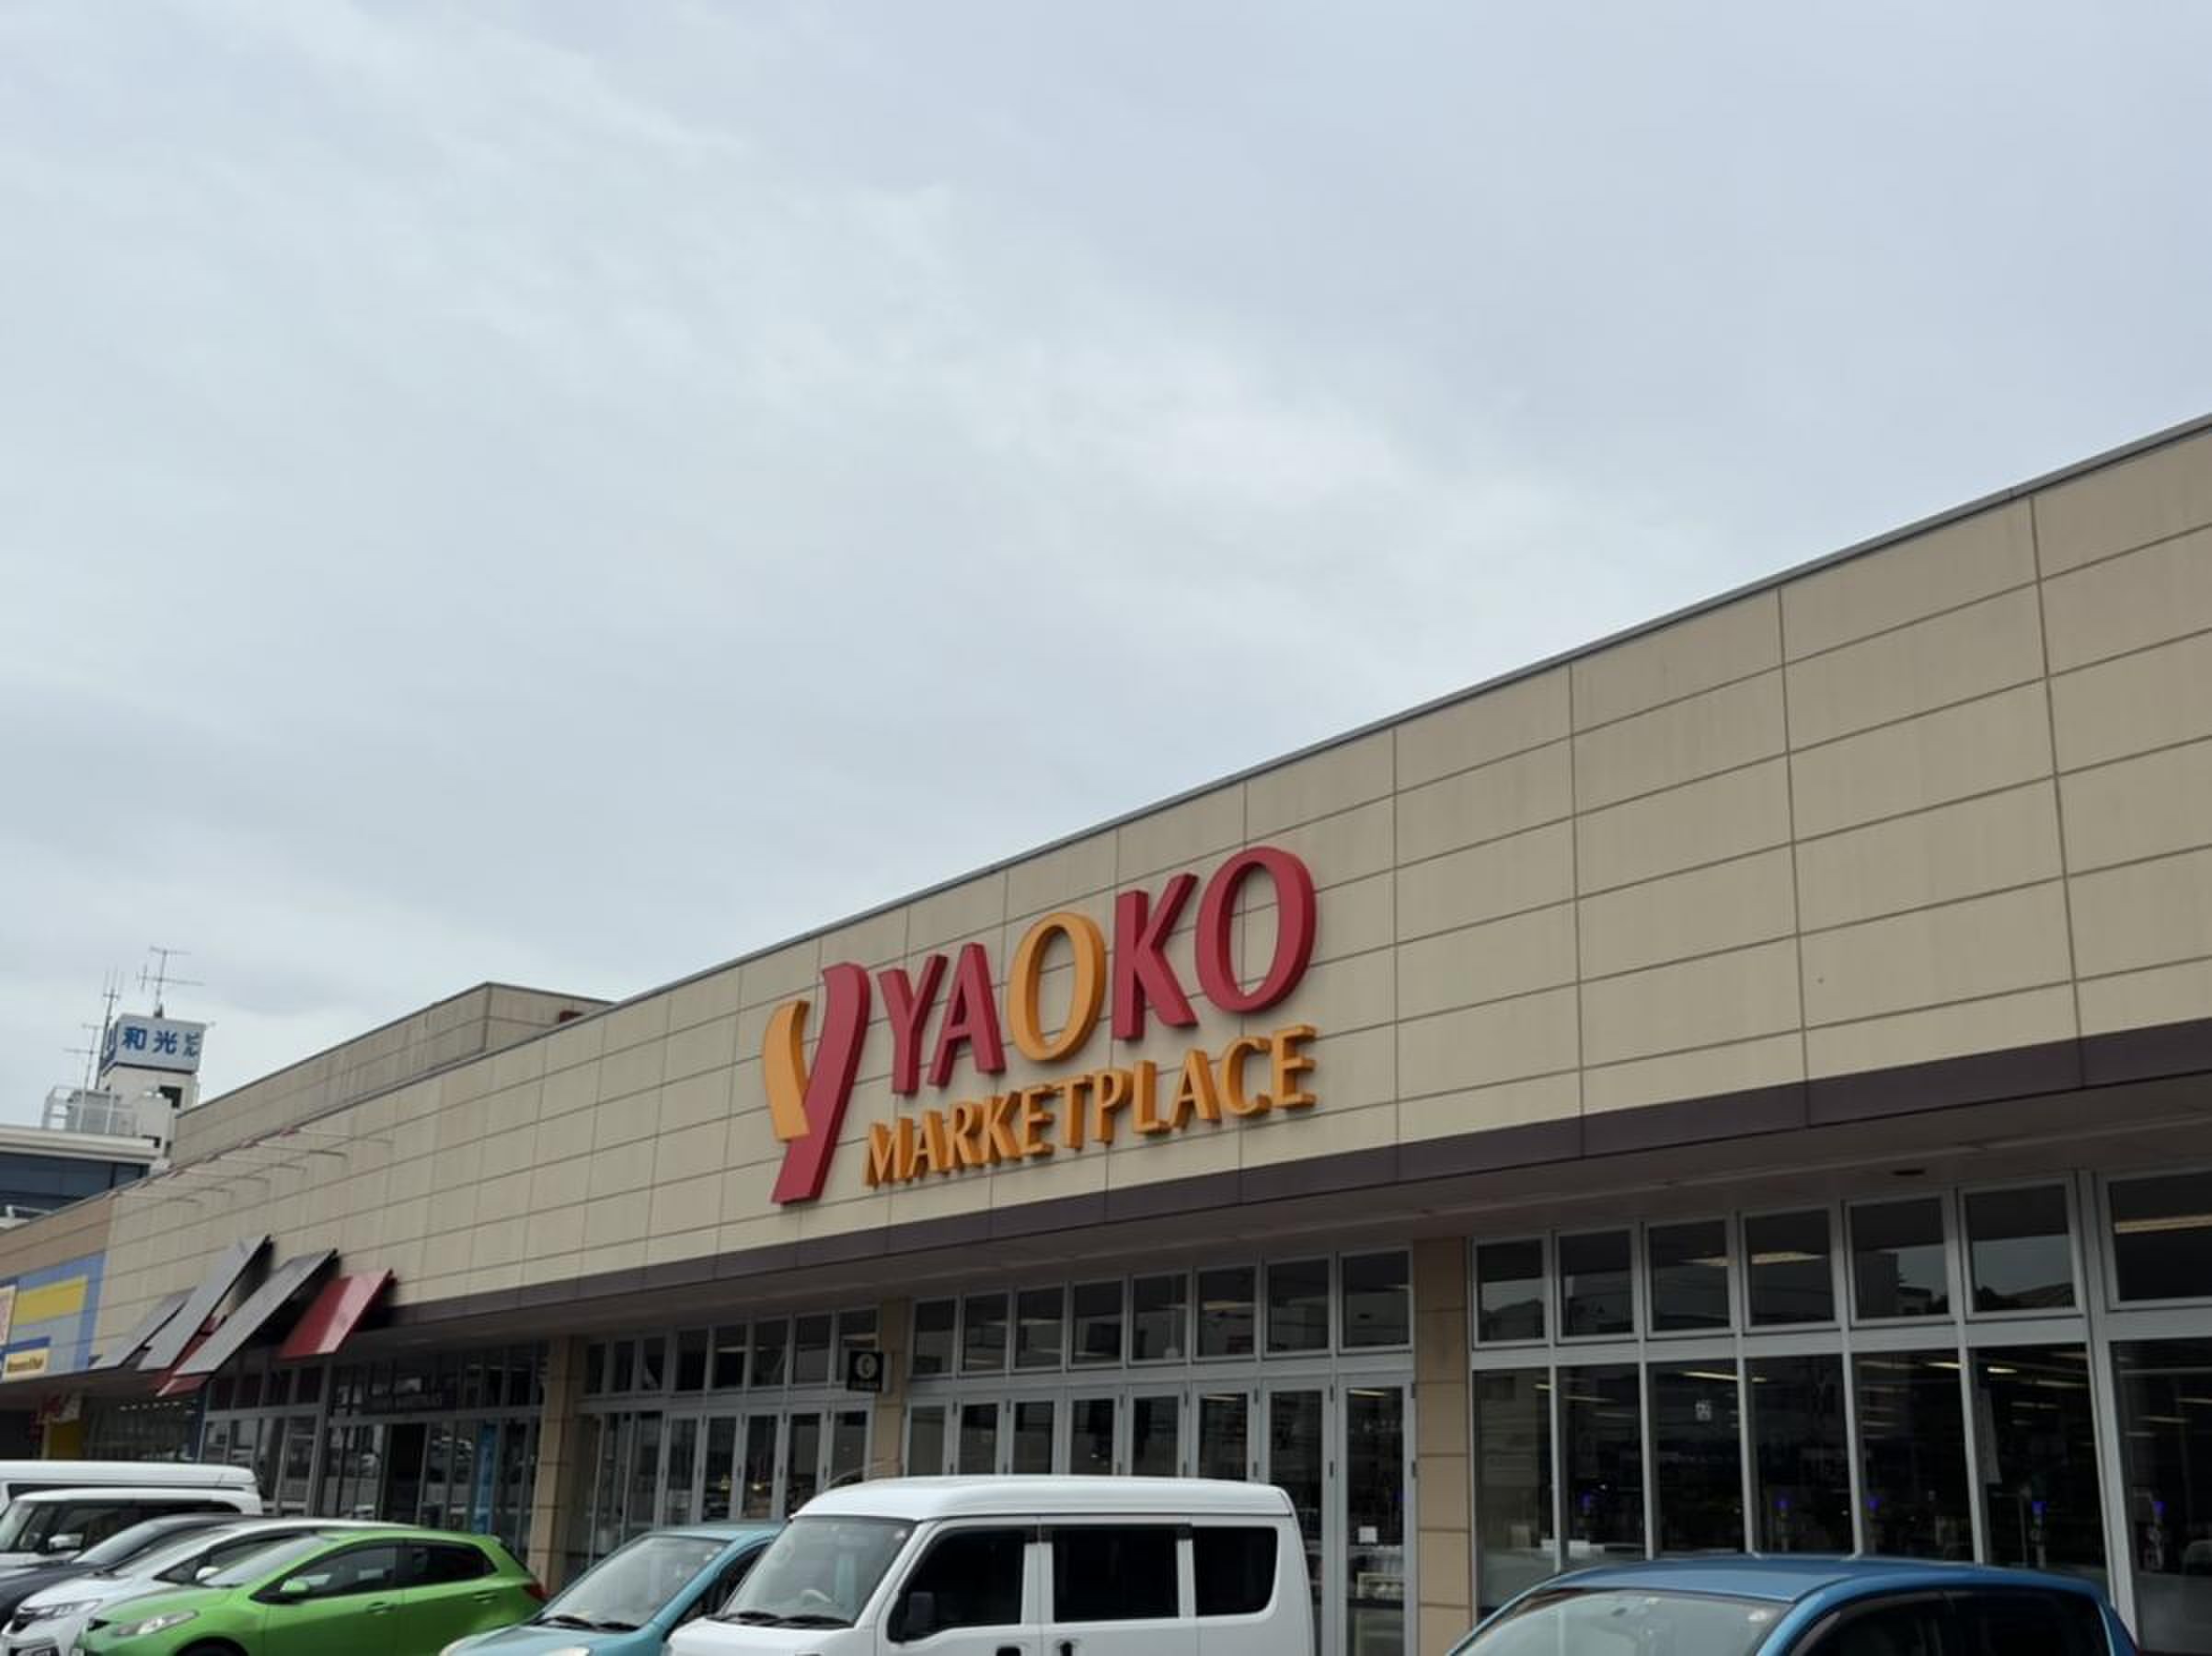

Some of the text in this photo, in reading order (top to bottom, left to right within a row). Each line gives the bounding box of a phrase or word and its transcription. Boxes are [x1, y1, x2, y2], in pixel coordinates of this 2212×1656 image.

[121, 1026, 178, 1055] 和光
[877, 845, 1317, 1097] YAOKO
[862, 1024, 1318, 1188] MARKETPLACE
